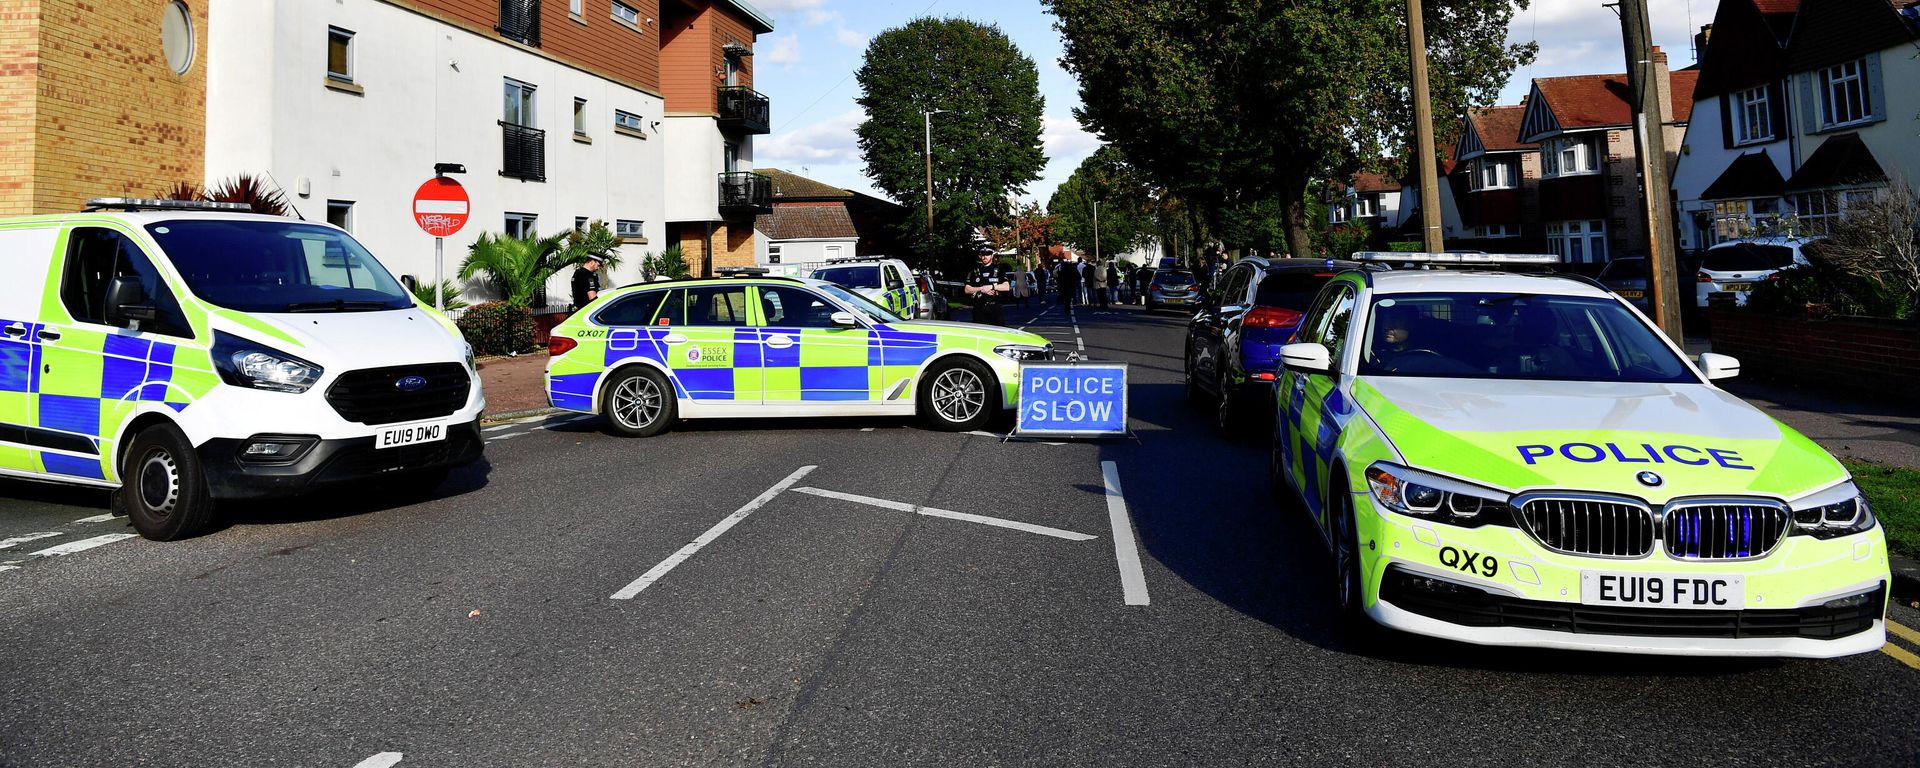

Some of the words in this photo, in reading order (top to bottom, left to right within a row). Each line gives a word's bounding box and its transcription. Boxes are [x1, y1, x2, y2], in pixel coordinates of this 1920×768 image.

[577, 330, 605, 338] QX07
[702, 347, 727, 355] ESSEX
[1031, 376, 1114, 394] POLICE
[1031, 400, 1113, 421] SLOW
[384, 428, 413, 446] EU19
[416, 425, 440, 441] DWO
[1516, 442, 1755, 471] POLICE
[1438, 546, 1498, 578] QX9
[1600, 575, 1664, 603] EU19
[1673, 578, 1728, 605] FDC
